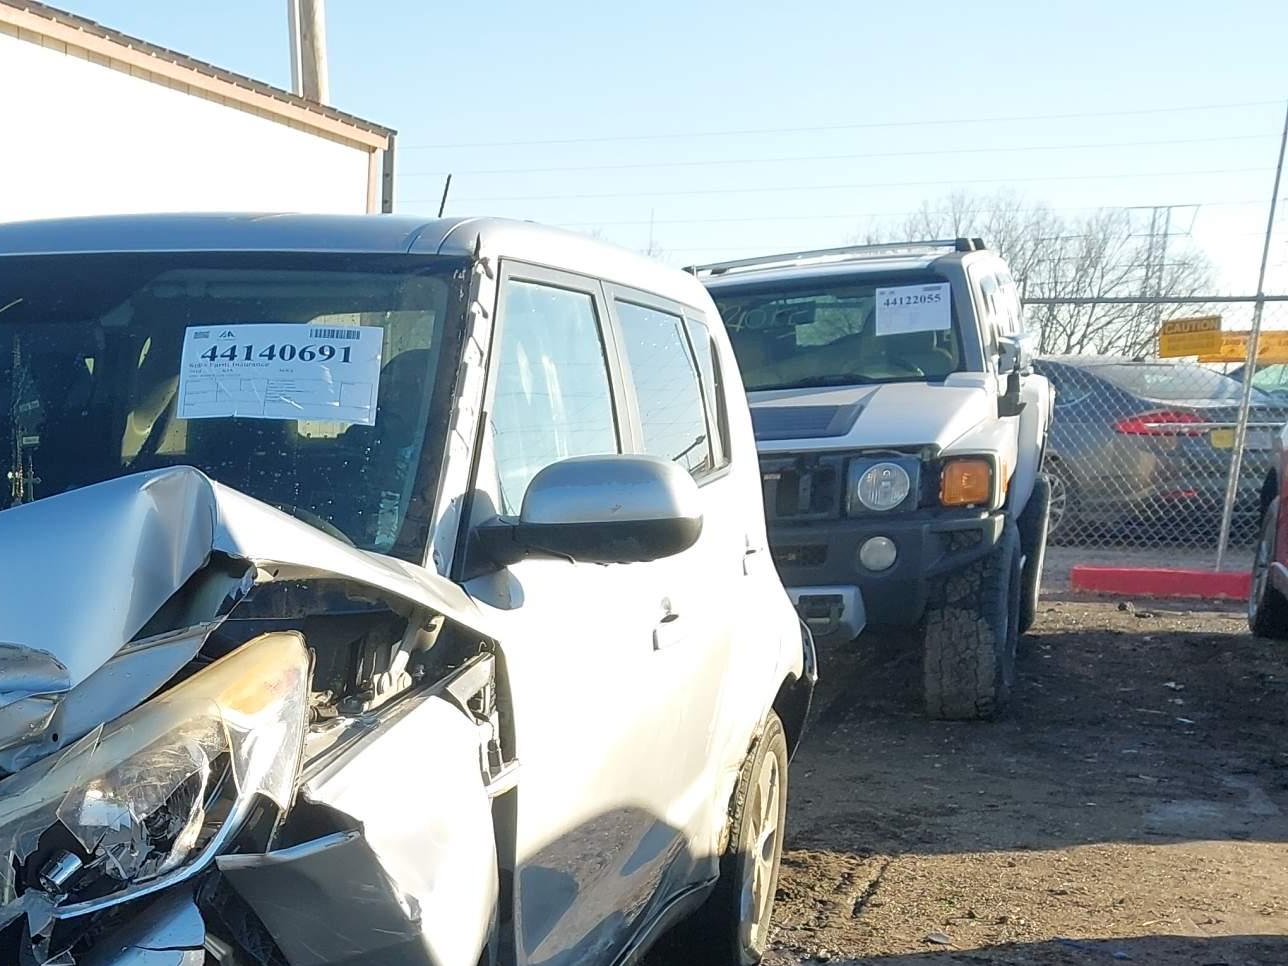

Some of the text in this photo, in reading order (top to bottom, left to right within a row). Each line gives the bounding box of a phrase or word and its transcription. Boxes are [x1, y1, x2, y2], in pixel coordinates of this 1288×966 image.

[883, 293, 942, 308] 44122055
[1165, 319, 1218, 334] CAUTION
[200, 343, 353, 364] 44140691
